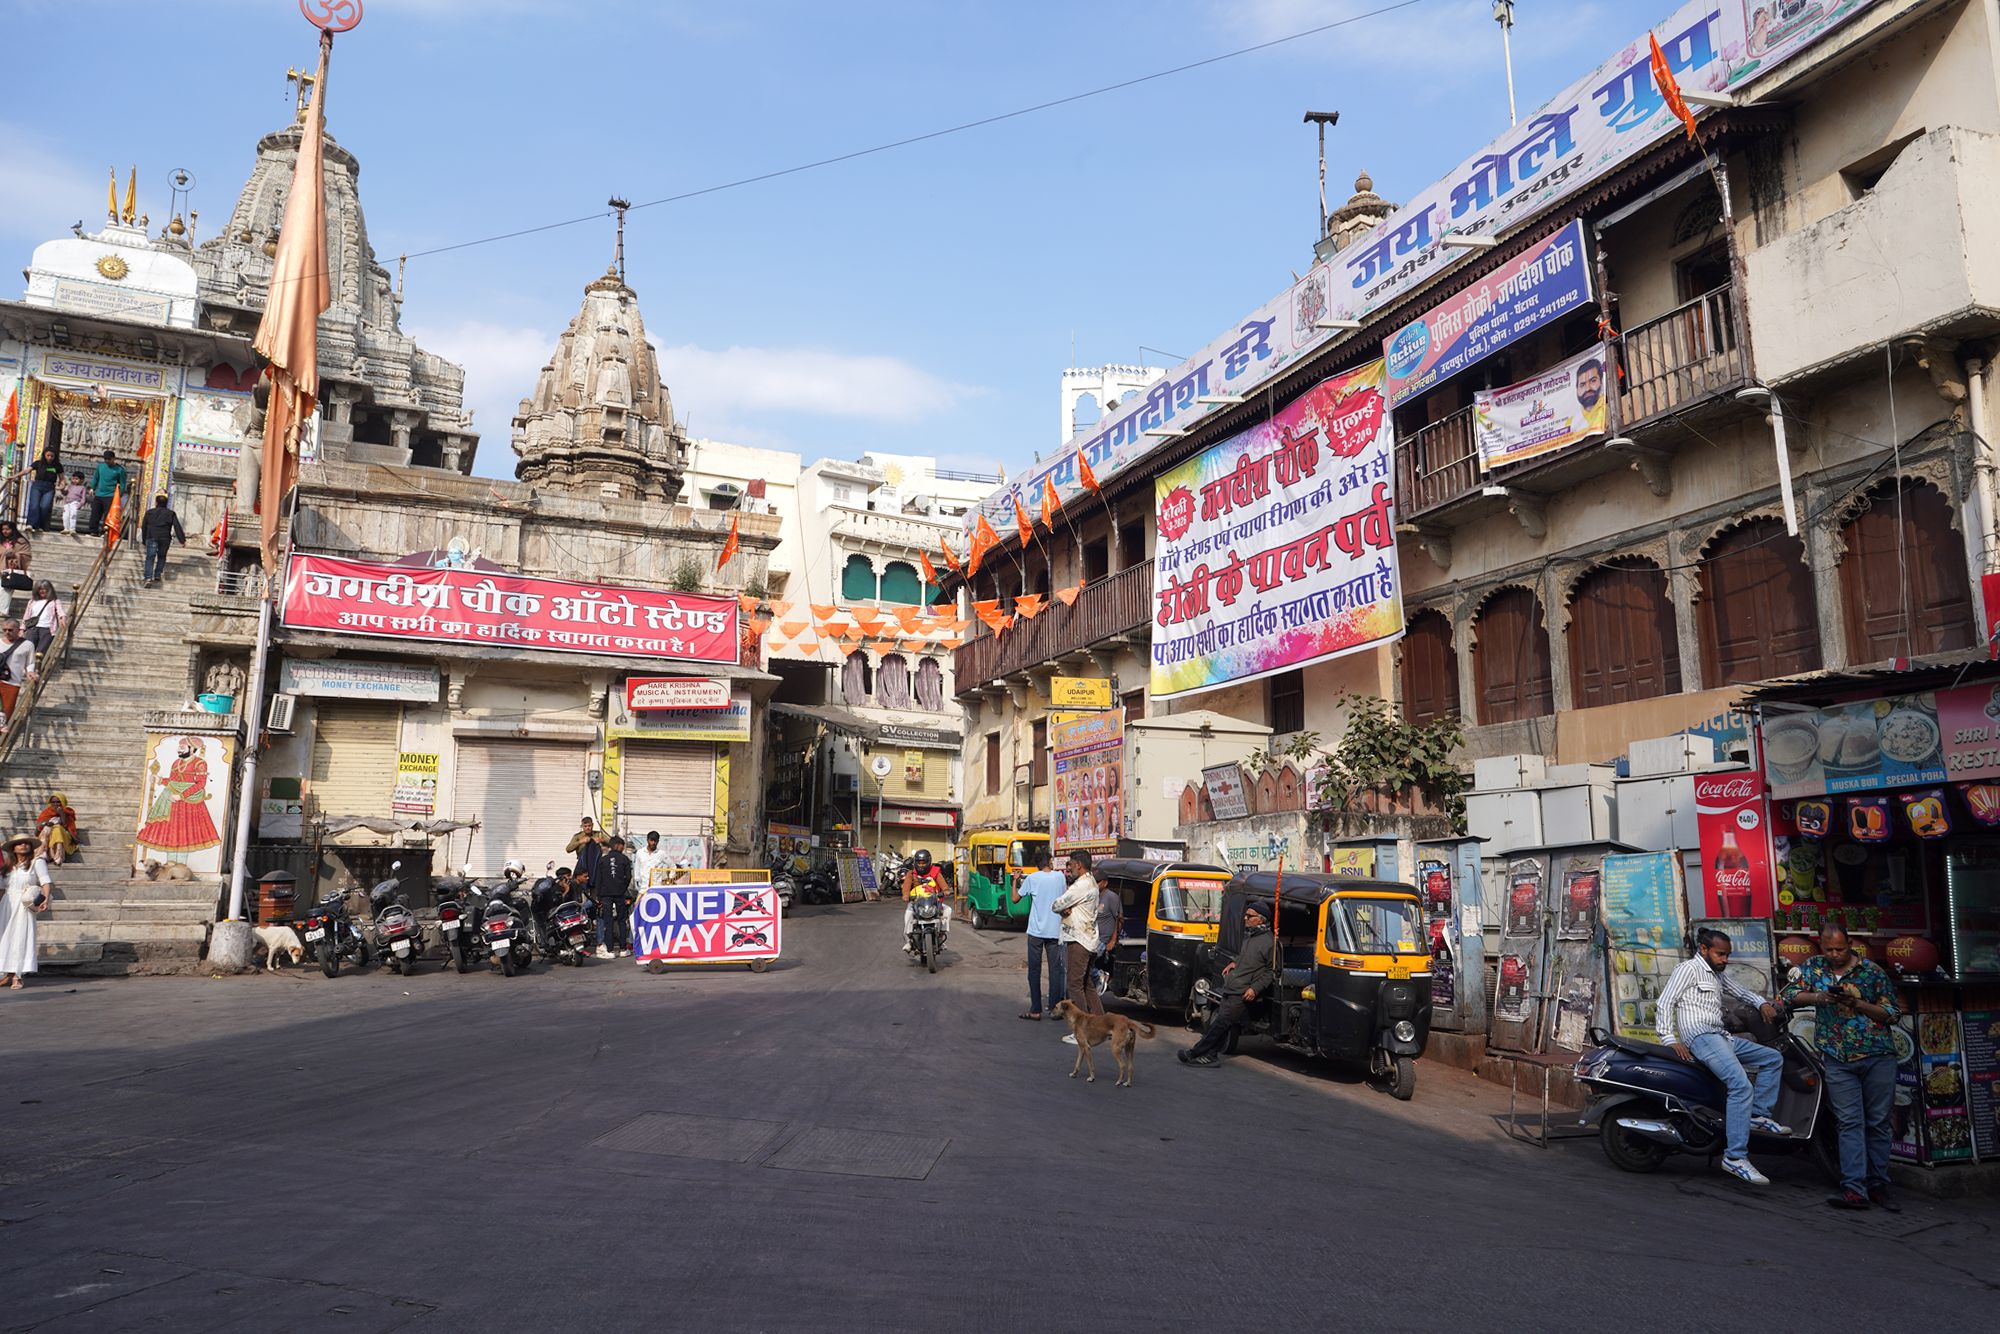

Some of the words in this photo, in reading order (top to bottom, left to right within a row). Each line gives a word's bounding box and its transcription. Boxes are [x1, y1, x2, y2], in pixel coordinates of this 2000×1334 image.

[1346, 203, 1438, 289] जय
[1450, 102, 1579, 219] भोले
[1364, 246, 1440, 302] जगदीश
[1500, 152, 1585, 215] उदयपुर
[1429, 308, 1463, 352] पुलिस
[1496, 260, 1545, 306] जगदीश
[1468, 320, 1490, 345] पुलिस
[1490, 312, 1509, 332] थाना
[1513, 293, 1540, 316] घंटाघर
[1440, 352, 1464, 375] उदयपुर
[1491, 325, 1508, 346] फोन
[1513, 288, 1579, 334] 0294-2411942
[1388, 334, 1427, 367] Active
[65, 361, 93, 378] जय
[94, 365, 142, 385] जगदीश
[143, 370, 161, 385] हरे
[1083, 358, 1214, 469] जगदीश
[1219, 315, 1277, 382] हरे
[1199, 450, 1275, 523] जगदीश
[1273, 426, 1320, 490] चौक
[1163, 496, 1188, 521] होली
[1212, 520, 1232, 551] एवं
[1308, 480, 1333, 511] की
[1371, 448, 1390, 476] से
[1155, 563, 1212, 629] होली
[1213, 550, 1247, 607] के
[1246, 523, 1334, 595] पावन
[1333, 482, 1396, 558] पर्व
[301, 573, 455, 610] जगदीश
[459, 579, 545, 618] चौक
[550, 590, 640, 628] ऑटो
[643, 599, 729, 635] स्टेण्ड
[1169, 634, 1196, 664] आप
[1195, 618, 1218, 658] सभी
[1215, 620, 1236, 650] का
[1236, 600, 1278, 646] हार्दिक
[1279, 588, 1331, 629] स्वागत
[1332, 569, 1377, 614] करता
[1376, 556, 1393, 600] है
[337, 610, 389, 630] आप
[389, 615, 438, 634] सभी
[438, 619, 473, 636] का
[475, 621, 544, 642] हार्दिक
[546, 629, 613, 648] स्वागत
[612, 634, 669, 652] करता
[321, 680, 354, 690] MONEY
[355, 681, 401, 692] EXCHANGE
[647, 682, 668, 690] HARE
[669, 681, 701, 689] KRISHNA
[673, 688, 723, 696] INSTRUMENT
[1066, 688, 1096, 696] UDAIPUR
[637, 697, 646, 706] हरे
[640, 721, 661, 729] Music
[660, 722, 682, 731] Events
[688, 723, 712, 731] Musical
[711, 724, 748, 733] Instruments
[881, 725, 898, 739] SV
[896, 729, 940, 740] COLLECTION
[1952, 724, 1991, 745] SHRI
[399, 753, 439, 766] MONEY
[399, 763, 438, 773] EXCHANGE
[1695, 777, 1754, 801] Coca-Cola
[1831, 778, 1860, 791] MUSKA
[1860, 776, 1879, 788] BUN
[1885, 773, 1921, 786] SPECIAL
[1920, 770, 1946, 783] POHA
[1738, 814, 1758, 825] ₹40/-
[1248, 846, 1260, 861] का
[1715, 869, 1751, 887] Coca-Cola
[638, 890, 720, 924] ONE
[637, 922, 721, 957] WAY
[1736, 940, 1768, 953] LASSI
